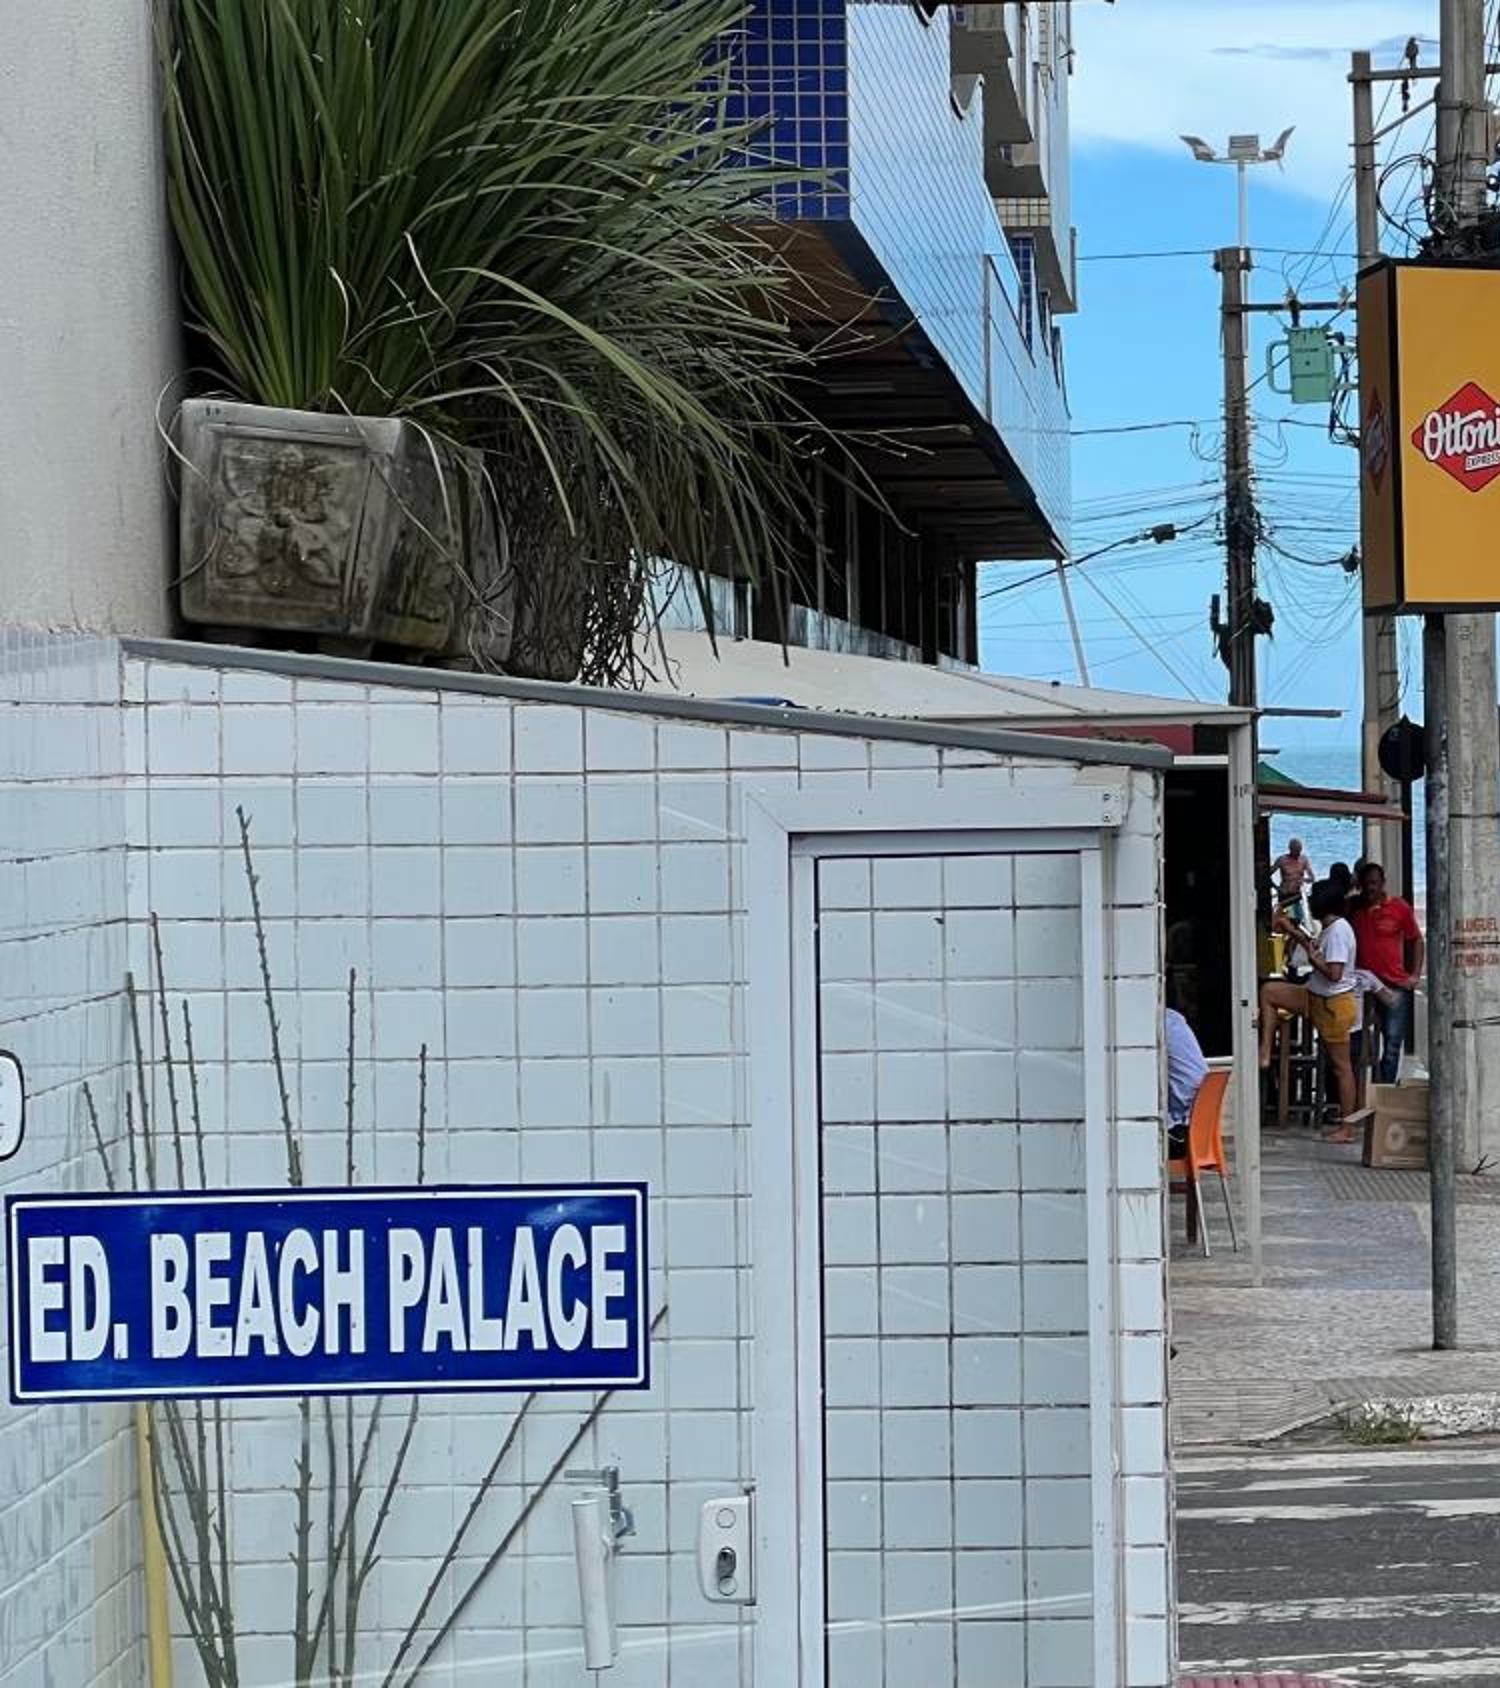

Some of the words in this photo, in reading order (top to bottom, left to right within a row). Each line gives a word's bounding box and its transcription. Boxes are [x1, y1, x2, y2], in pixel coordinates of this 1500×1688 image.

[28, 1235, 128, 1362] ED.
[151, 1229, 366, 1359] BEACH
[388, 1223, 628, 1353] PALACE
